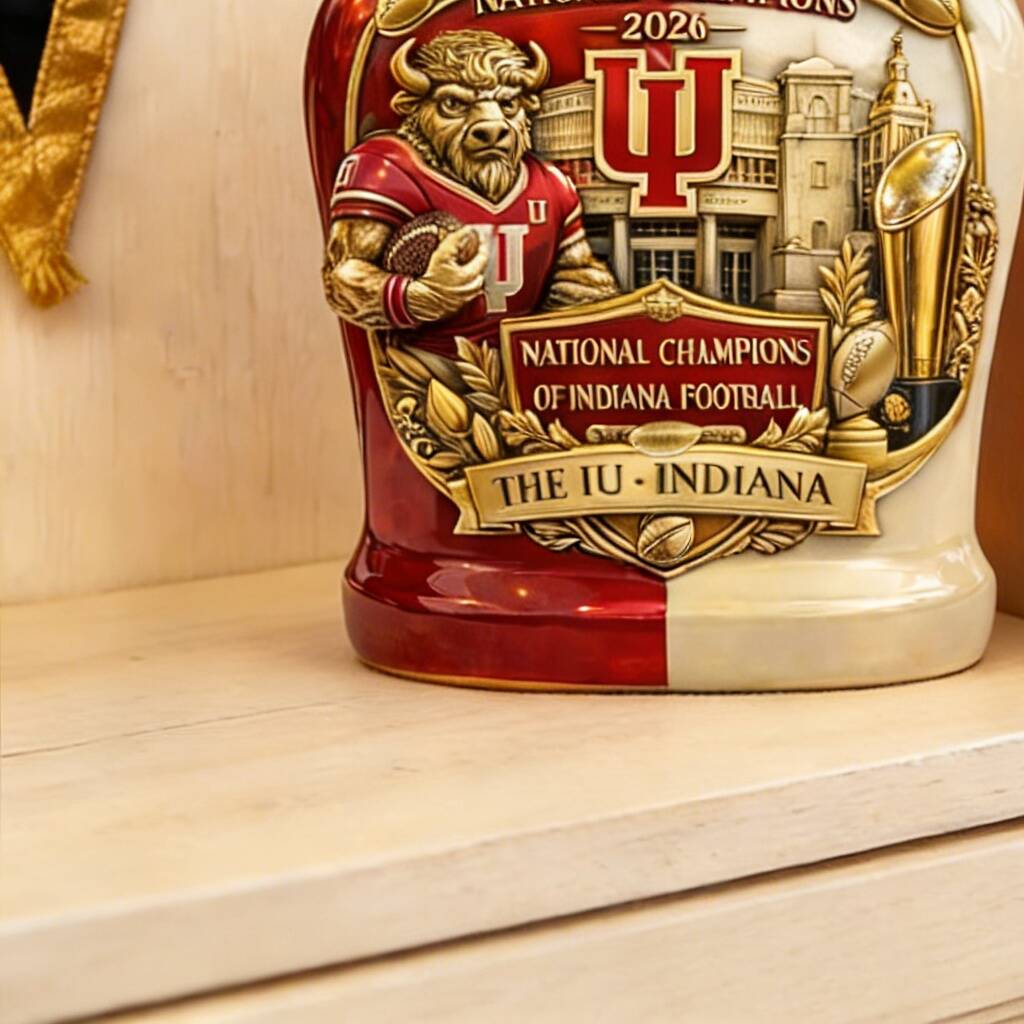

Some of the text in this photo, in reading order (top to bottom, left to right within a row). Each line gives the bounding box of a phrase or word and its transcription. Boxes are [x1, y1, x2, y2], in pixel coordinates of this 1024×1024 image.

[621, 10, 708, 41] 2026
[520, 337, 812, 367] NATIONAL CHAMPIONS
[533, 381, 804, 411] OF INDIANA FOOTBALL
[493, 467, 568, 508] THE
[581, 464, 623, 497] IU
[653, 461, 833, 506] INDIANA
